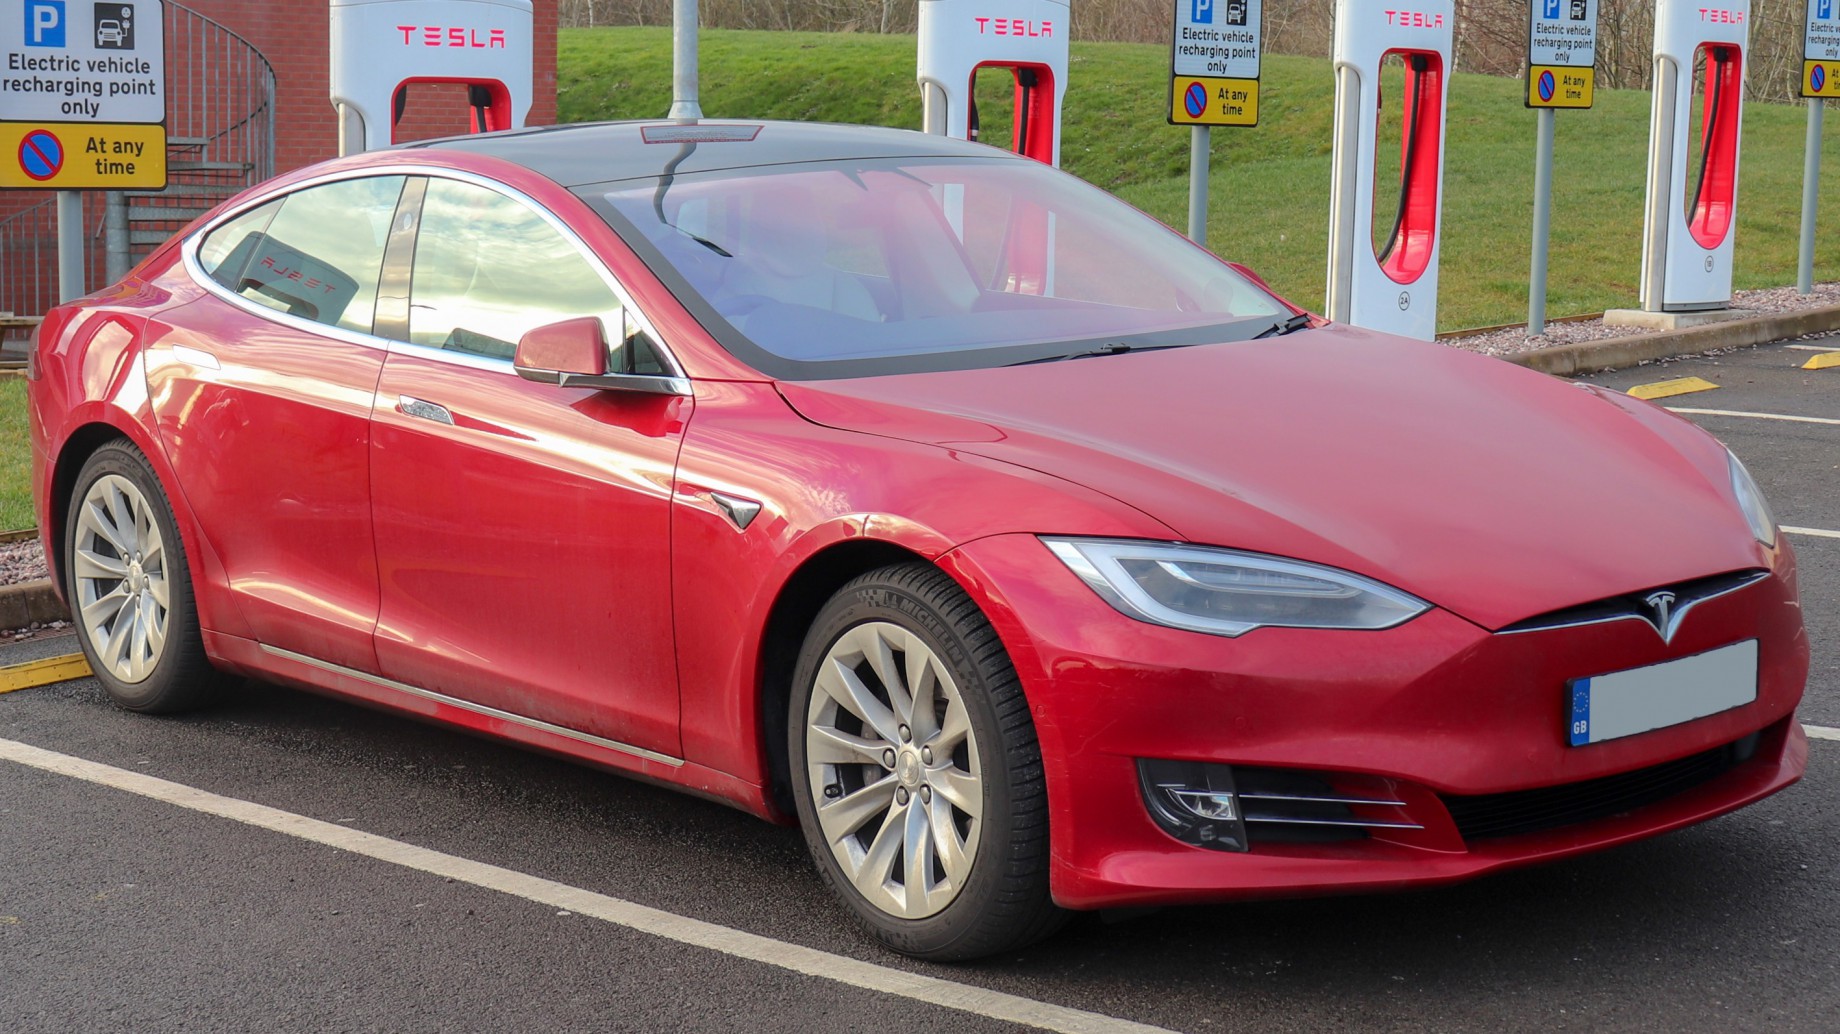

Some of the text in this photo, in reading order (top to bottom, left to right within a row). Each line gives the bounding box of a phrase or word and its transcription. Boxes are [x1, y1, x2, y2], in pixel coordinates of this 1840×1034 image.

[34, 5, 58, 42] P
[1384, 10, 1443, 29] TESLA
[1699, 8, 1744, 24] TESLA
[974, 17, 1052, 38] TESLA
[1182, 27, 1254, 43] Electric vehicle
[1536, 23, 1591, 36] Electric vehicle
[1811, 22, 1834, 33] Electric
[396, 25, 505, 49] TESLA
[1533, 37, 1593, 50] recharging point
[1808, 35, 1840, 47] recharging
[1179, 44, 1256, 59] recharging point
[1554, 51, 1570, 63] only
[1825, 47, 1838, 58] only
[8, 53, 150, 74] Electric vehicle
[1207, 60, 1228, 74] only
[1563, 75, 1585, 88] At any
[1832, 69, 1839, 79] At
[3, 76, 156, 97] recharging point
[1565, 88, 1582, 99] time
[1218, 88, 1248, 103] At any
[61, 98, 100, 118] only
[1222, 103, 1243, 115] time
[85, 137, 144, 157] At any
[95, 158, 136, 175] time
[1573, 720, 1587, 735] GB
